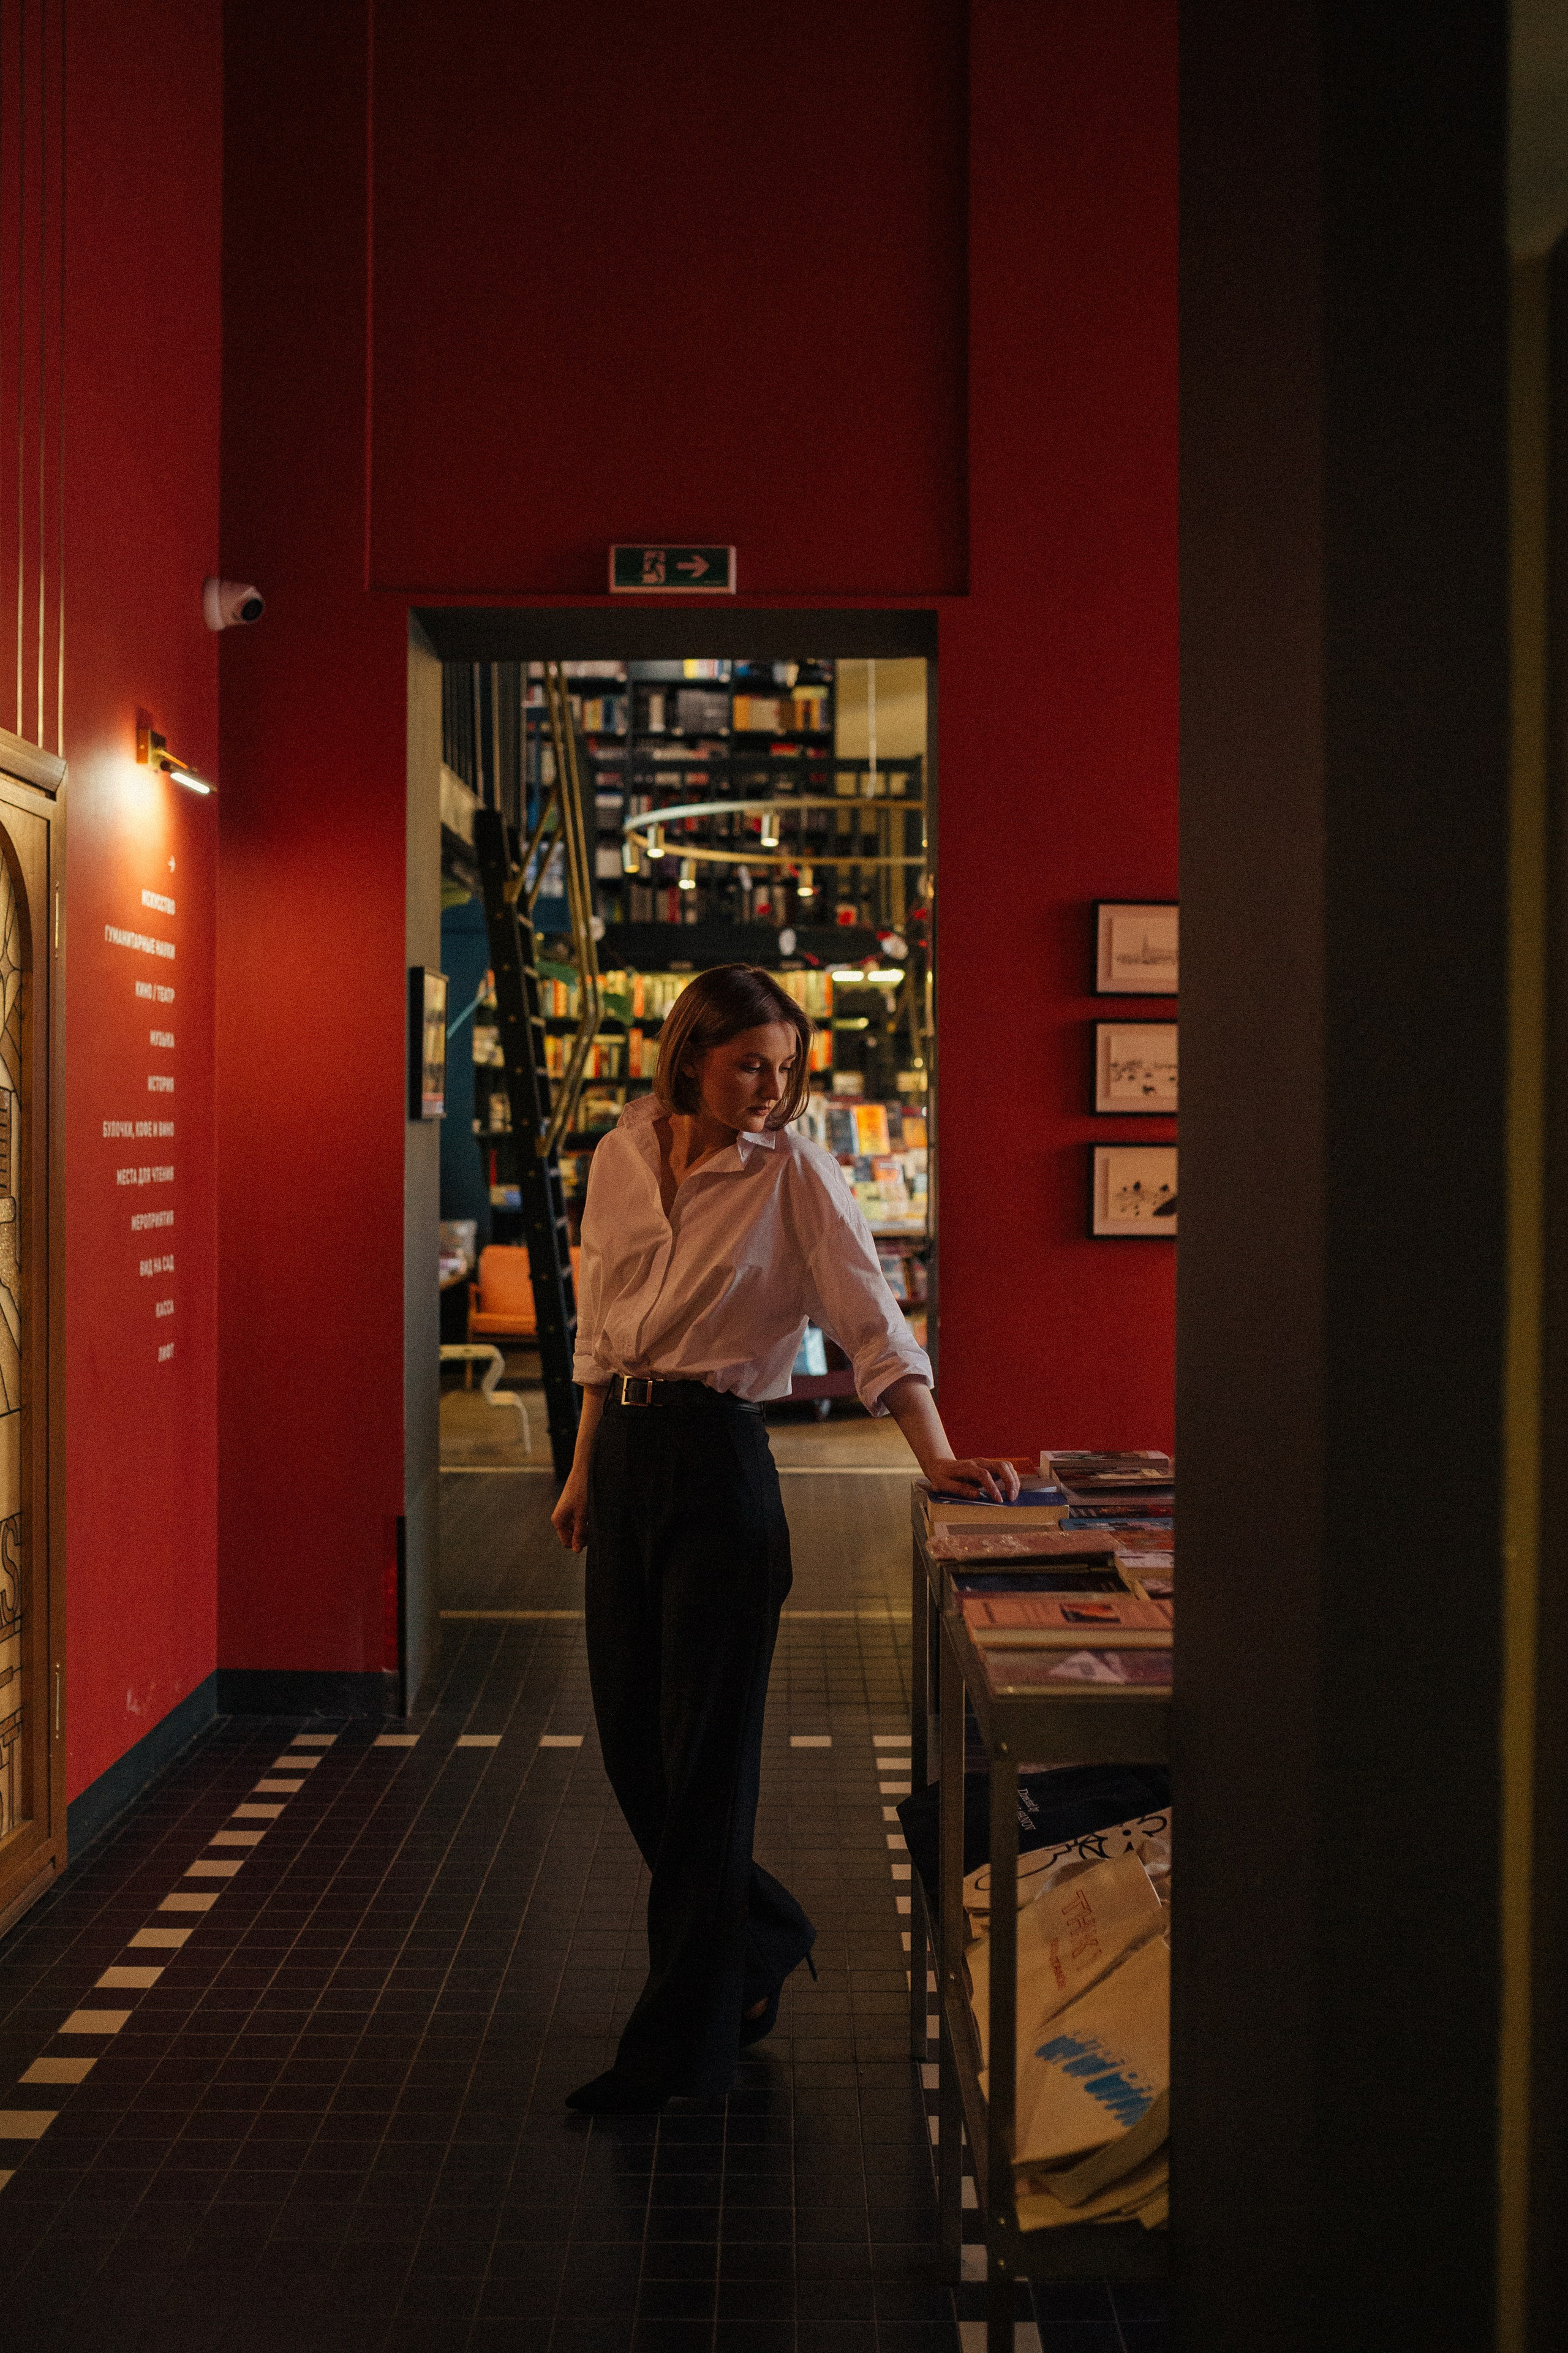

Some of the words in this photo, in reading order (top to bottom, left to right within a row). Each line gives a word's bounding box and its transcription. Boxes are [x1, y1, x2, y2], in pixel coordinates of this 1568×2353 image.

[103, 1121, 135, 1138] БУЛОЧКИ,
[136, 1121, 152, 1137] КОФЕ
[153, 1122, 157, 1136] И
[116, 1168, 137, 1185] МЕСТА
[138, 1167, 151, 1187] ДЛЯ
[152, 1165, 174, 1182] ЧТЕНИЯ
[131, 1210, 174, 1231] МЕРОПРИЯТИЯ
